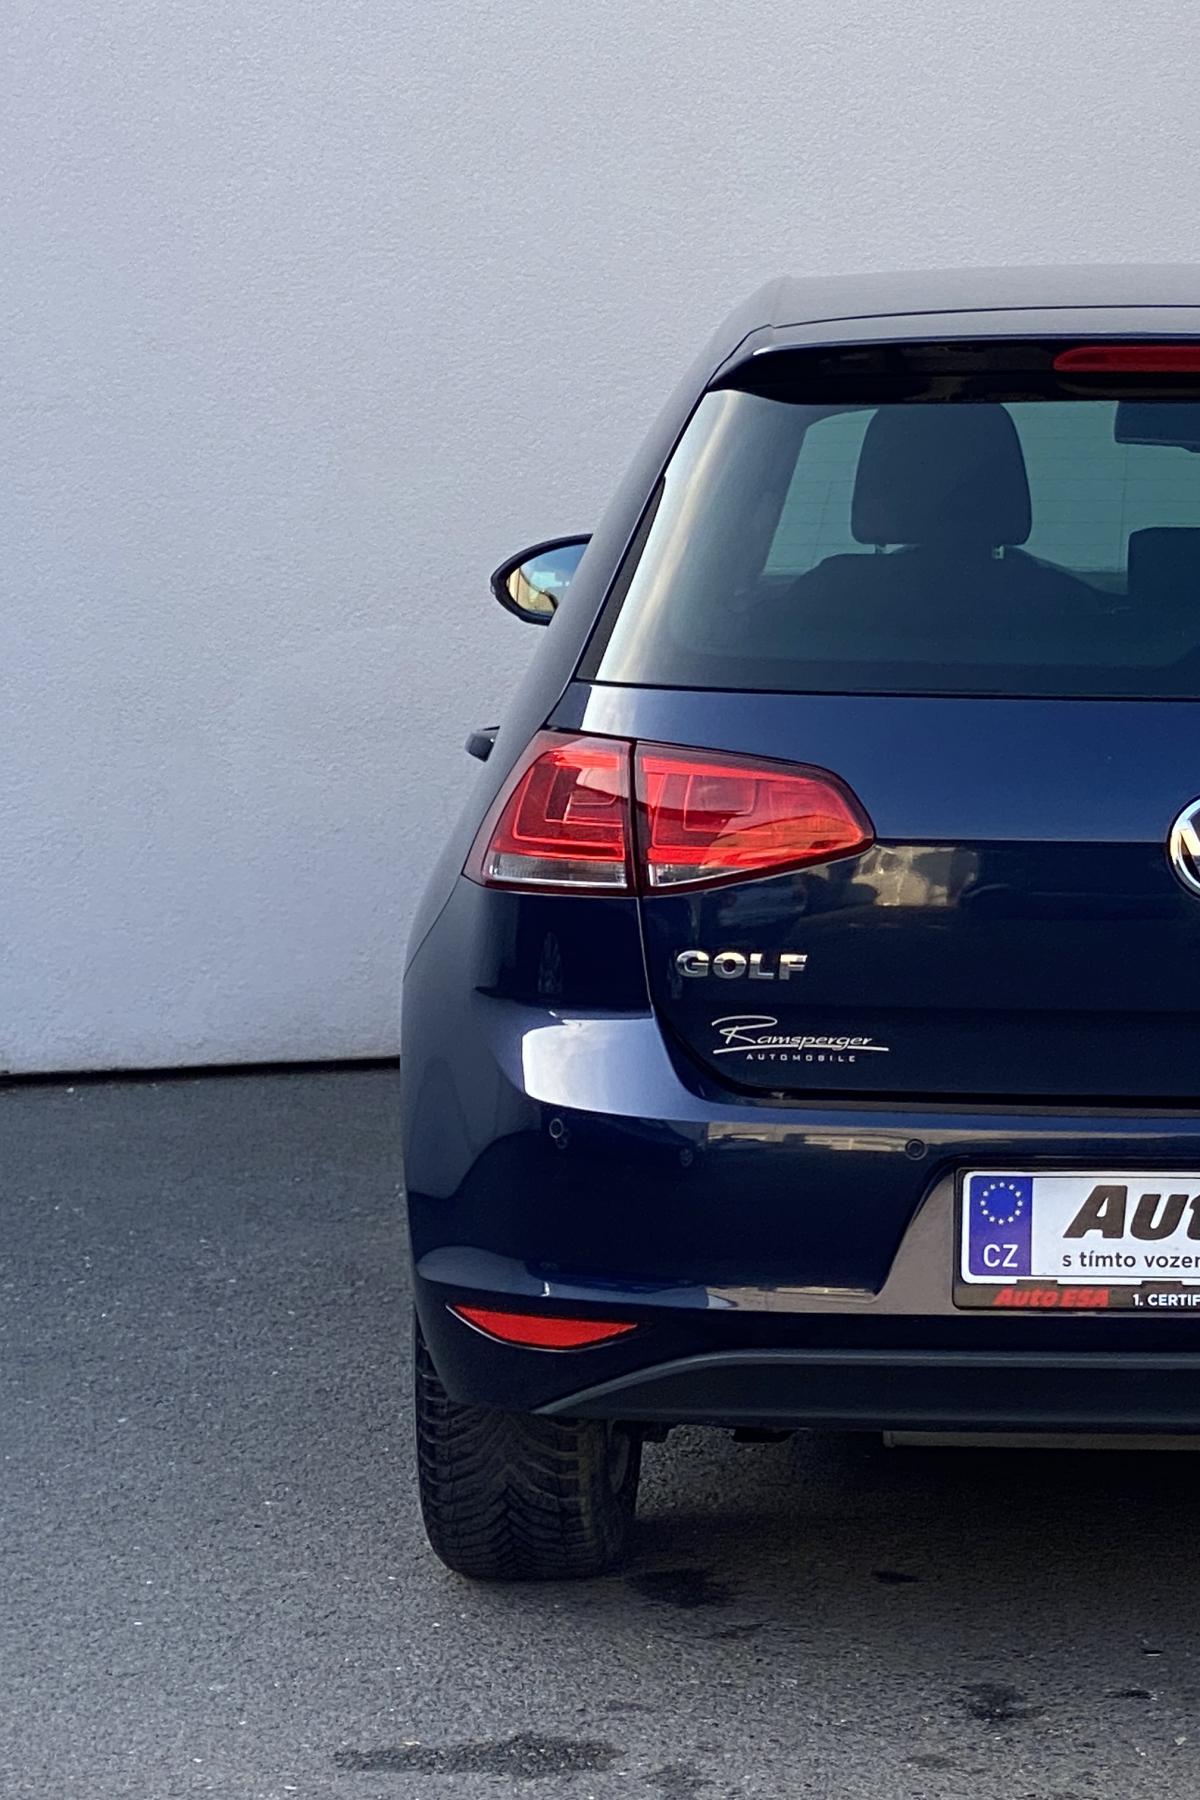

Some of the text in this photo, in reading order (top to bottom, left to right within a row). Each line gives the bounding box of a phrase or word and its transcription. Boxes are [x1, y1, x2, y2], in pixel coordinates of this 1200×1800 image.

[676, 950, 808, 980] GOLF
[711, 1014, 873, 1051] Ramsperger
[746, 1053, 856, 1063] AUTOMOBILE
[982, 1244, 1018, 1268] CZ
[1061, 1255, 1073, 1267] s
[1079, 1250, 1137, 1268] tímto
[993, 1288, 1110, 1308] Auto ESA
[1132, 1293, 1145, 1306] 1.
